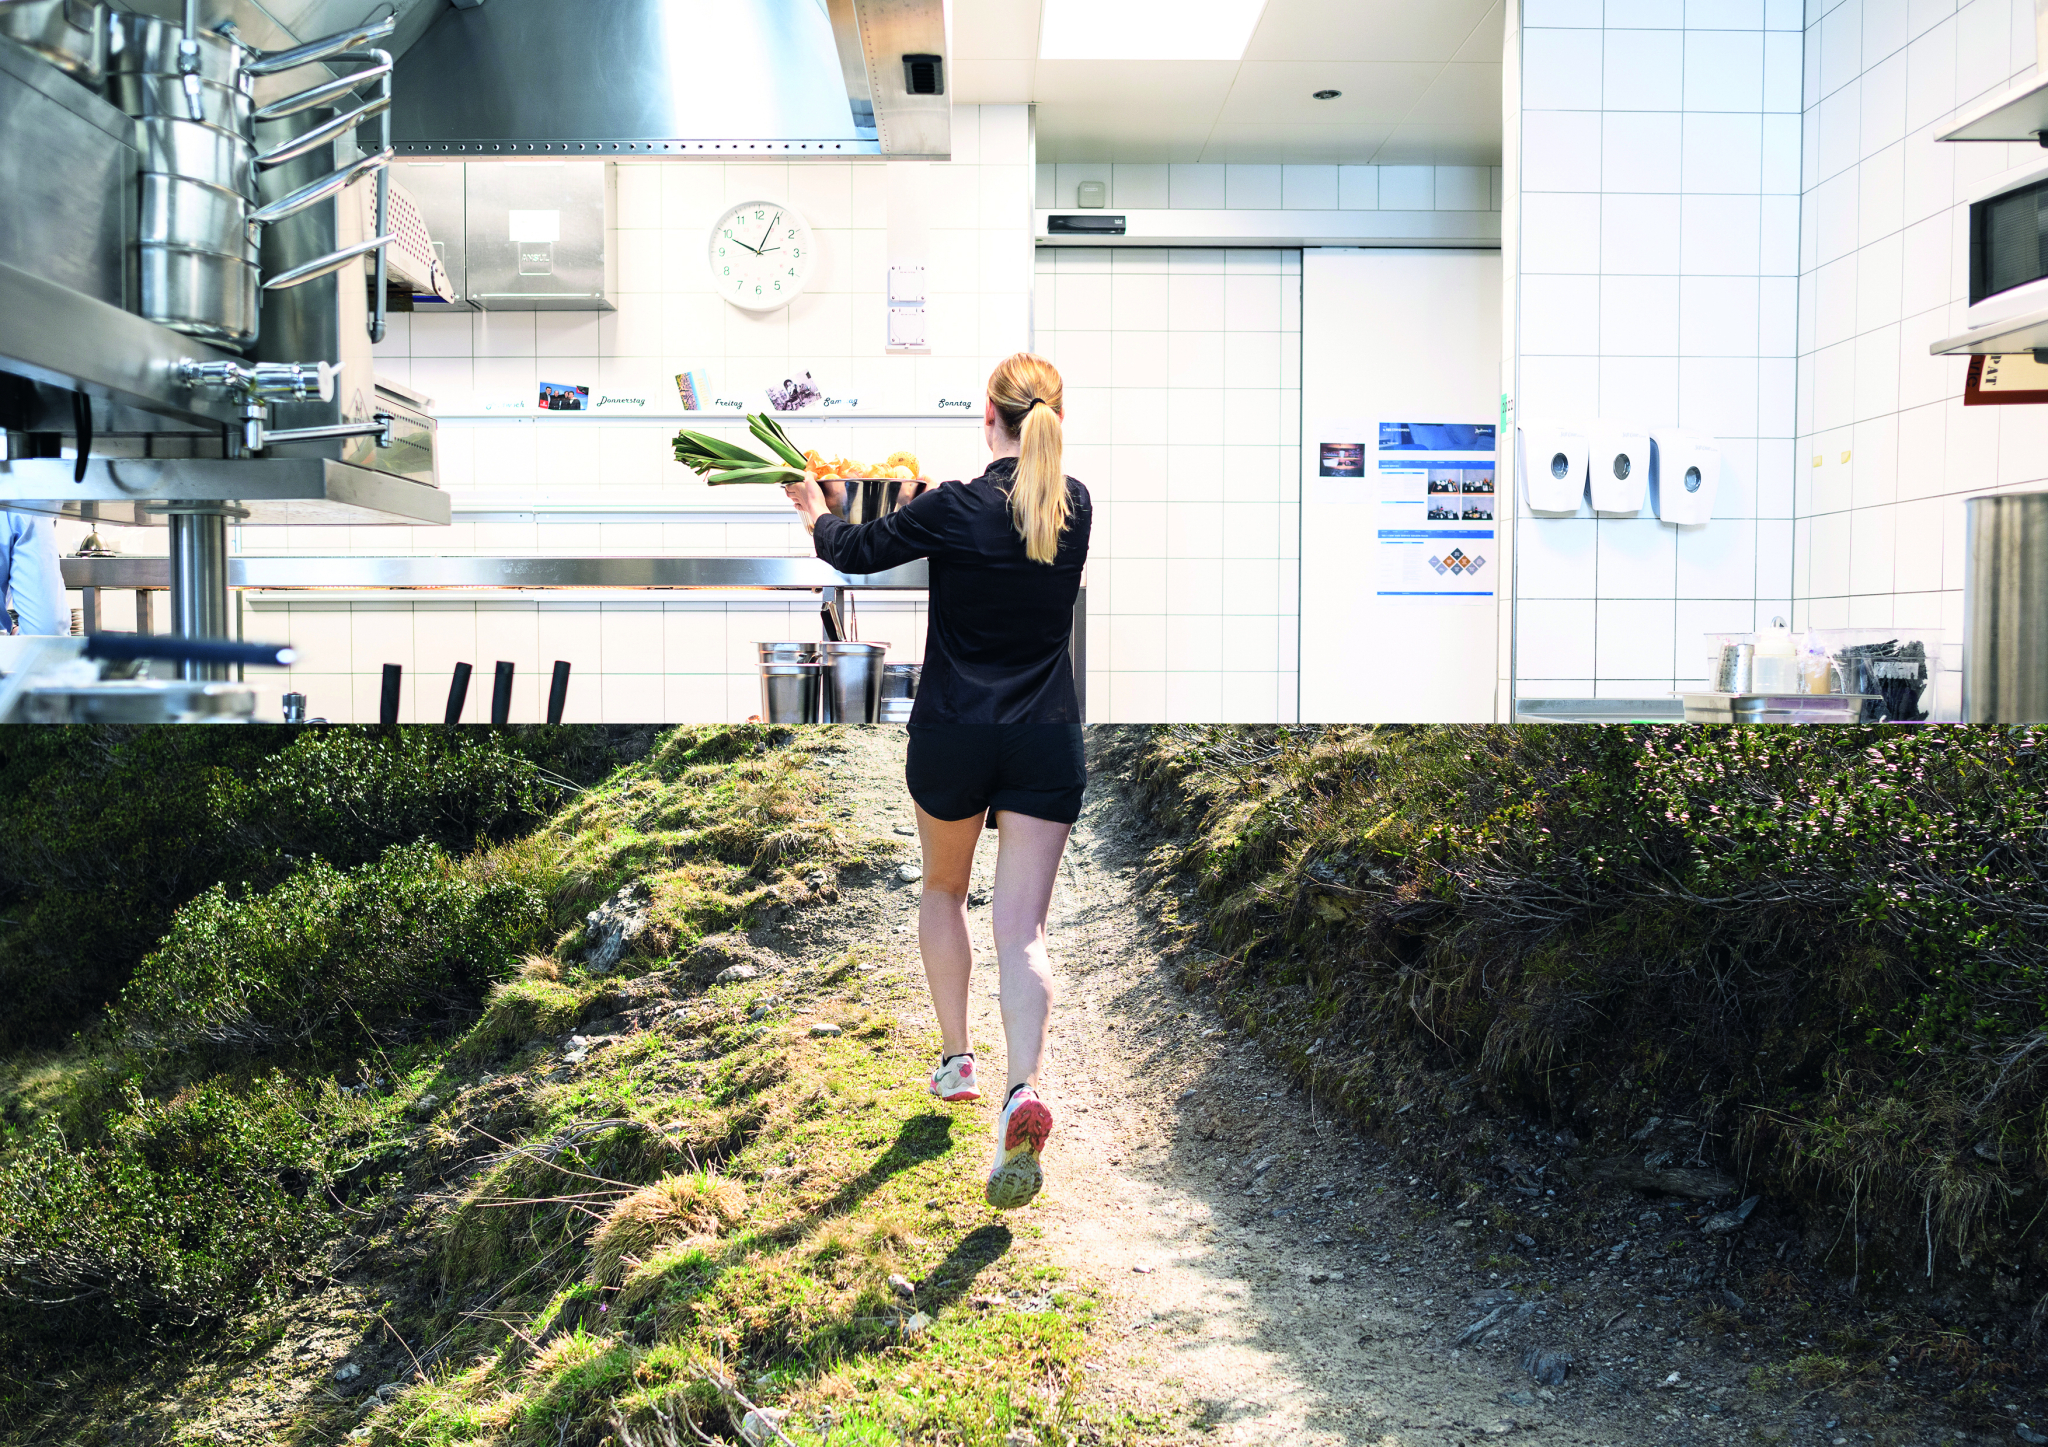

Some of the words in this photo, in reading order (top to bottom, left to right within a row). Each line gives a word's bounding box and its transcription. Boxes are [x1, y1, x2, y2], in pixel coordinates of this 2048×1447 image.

[737, 216, 745, 225] 11
[754, 210, 765, 221] 12
[723, 229, 733, 239] 10
[788, 229, 795, 239] 2
[718, 247, 726, 257] 9
[793, 248, 800, 258] 3
[522, 253, 550, 262] ANSUL
[723, 266, 730, 276] 8
[788, 267, 795, 277] 4
[737, 280, 743, 290] 7
[755, 285, 762, 295] 6
[774, 280, 781, 291] 5
[596, 395, 646, 407] Donnerstag
[715, 398, 743, 410] Freitag
[823, 396, 859, 407] Samag
[937, 398, 972, 410] Sonntag
